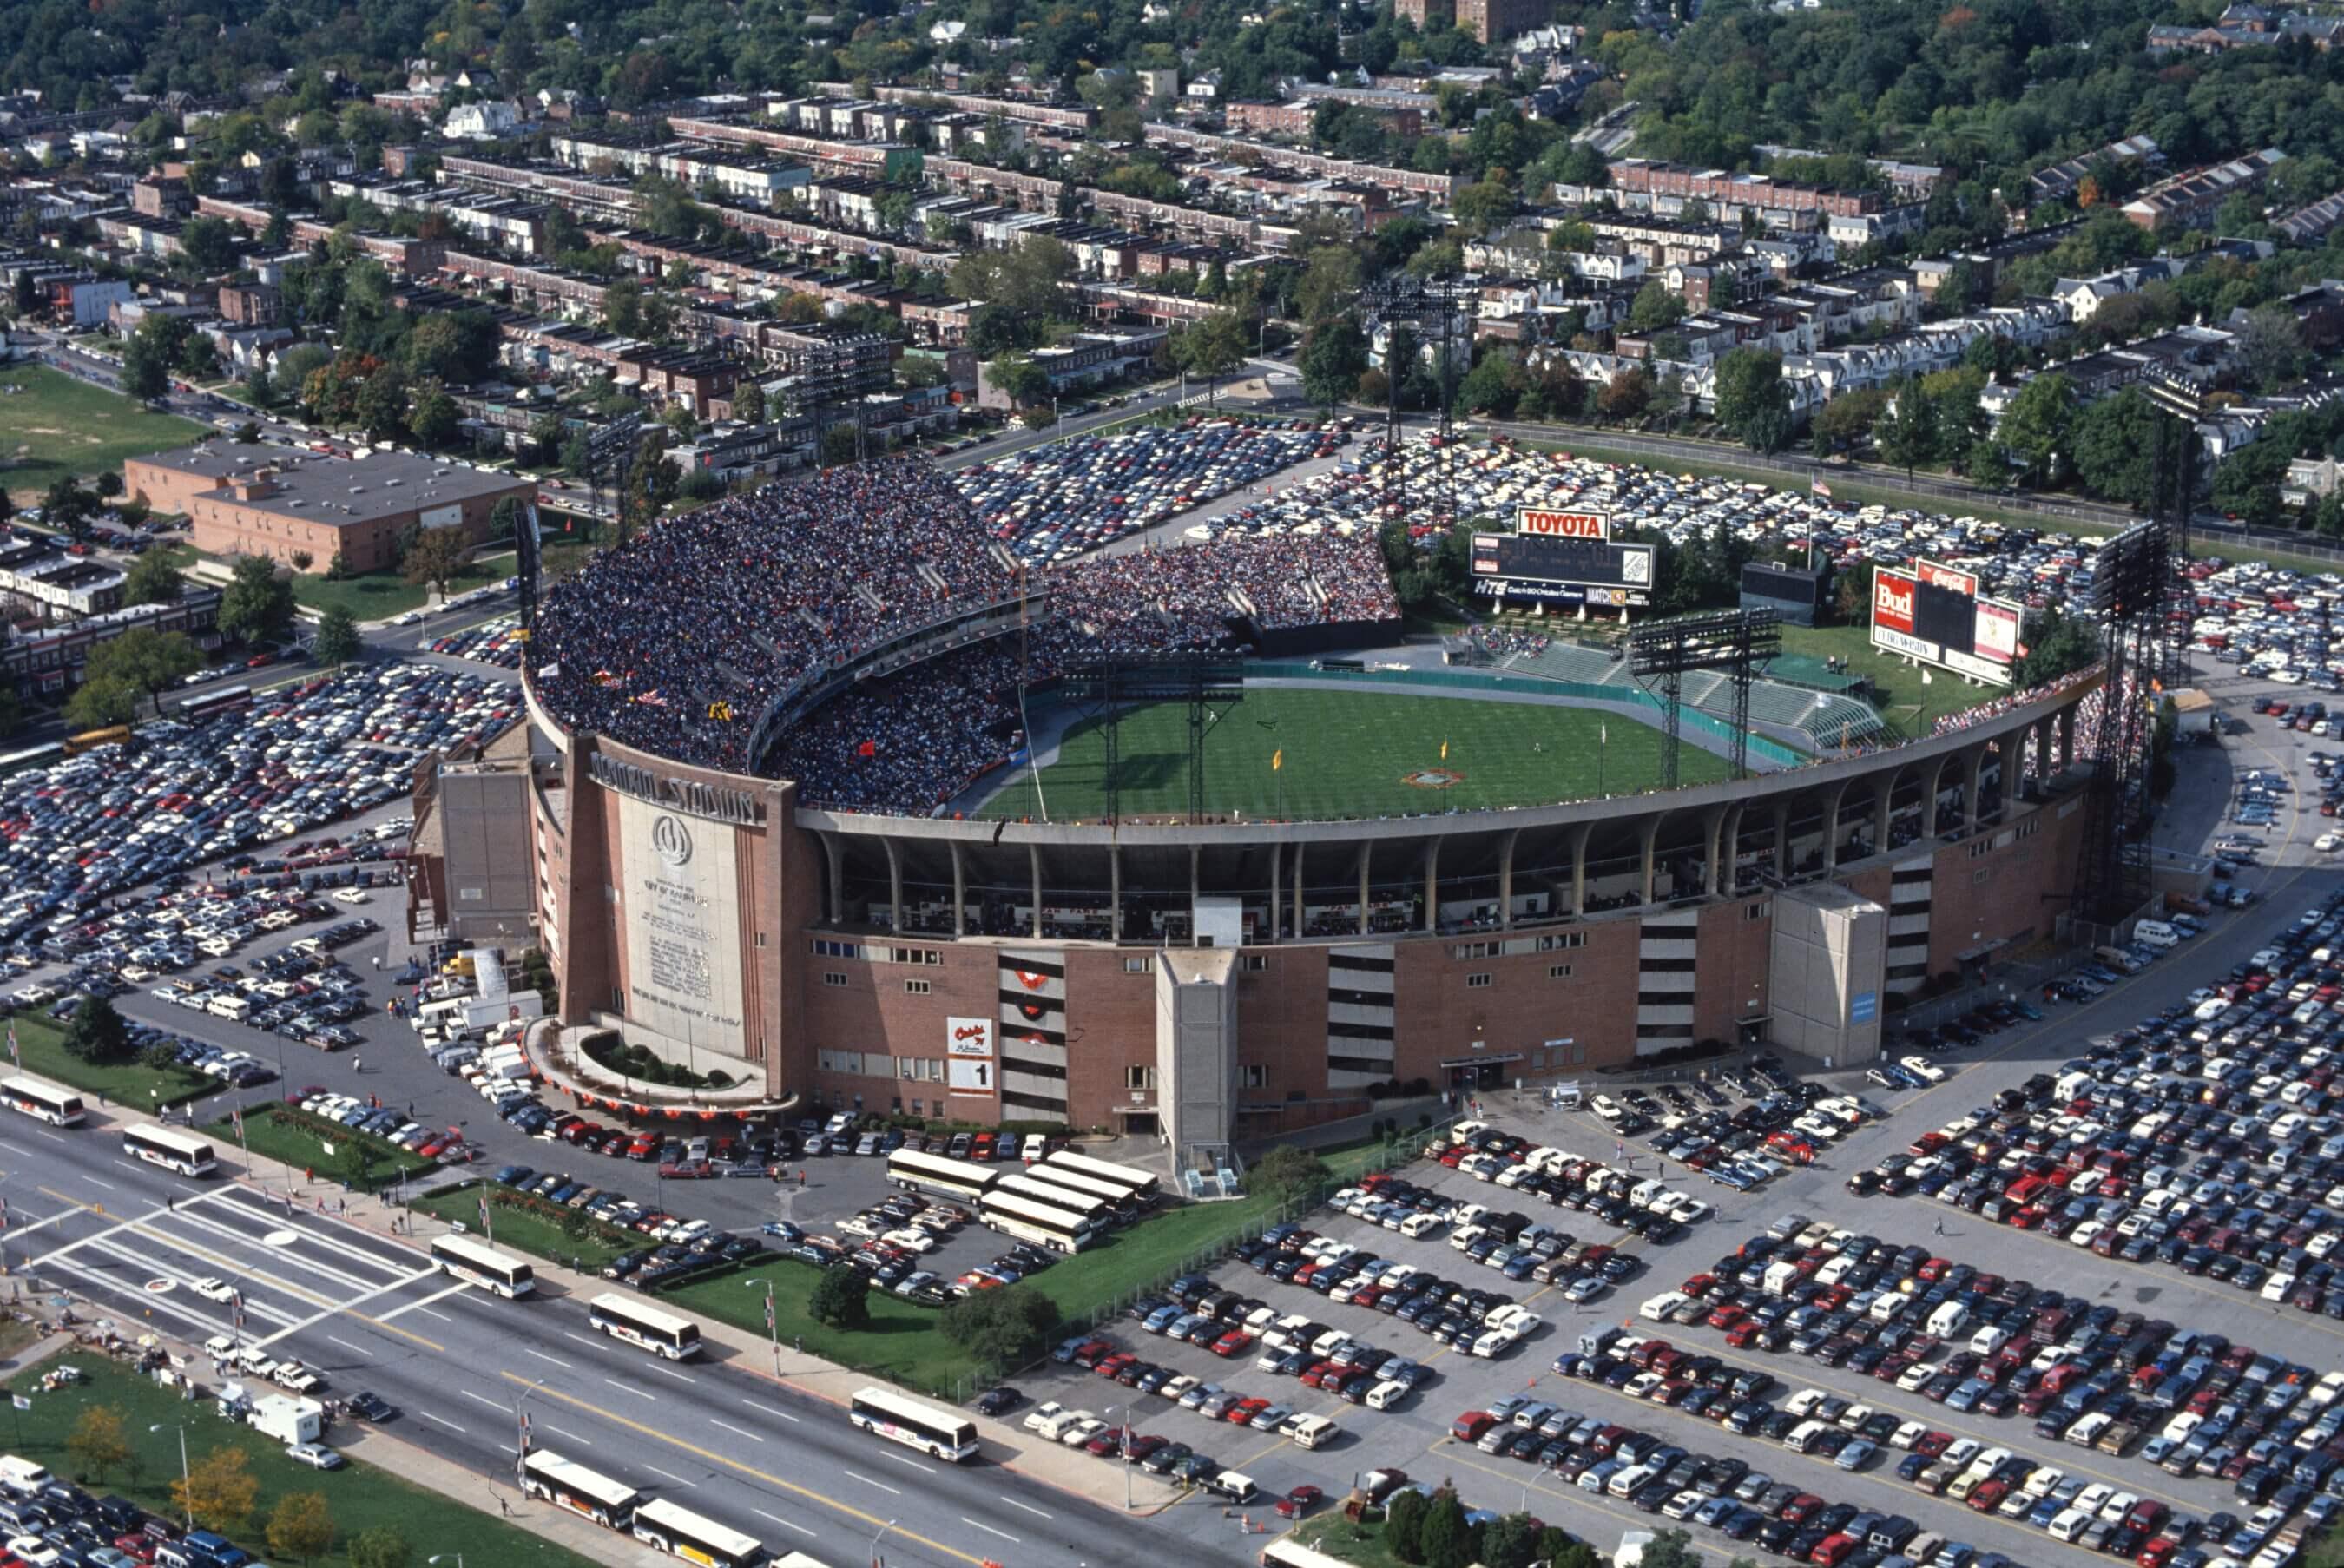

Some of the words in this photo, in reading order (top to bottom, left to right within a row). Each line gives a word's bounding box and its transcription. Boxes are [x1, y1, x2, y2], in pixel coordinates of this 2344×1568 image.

[1524, 512, 1601, 537] TOYOTA
[1474, 580, 1508, 596] HTS
[1587, 588, 1612, 604] MATCH
[1877, 583, 1913, 616] Bud
[668, 777, 755, 823] STADIUM
[976, 1064, 987, 1085] 1
